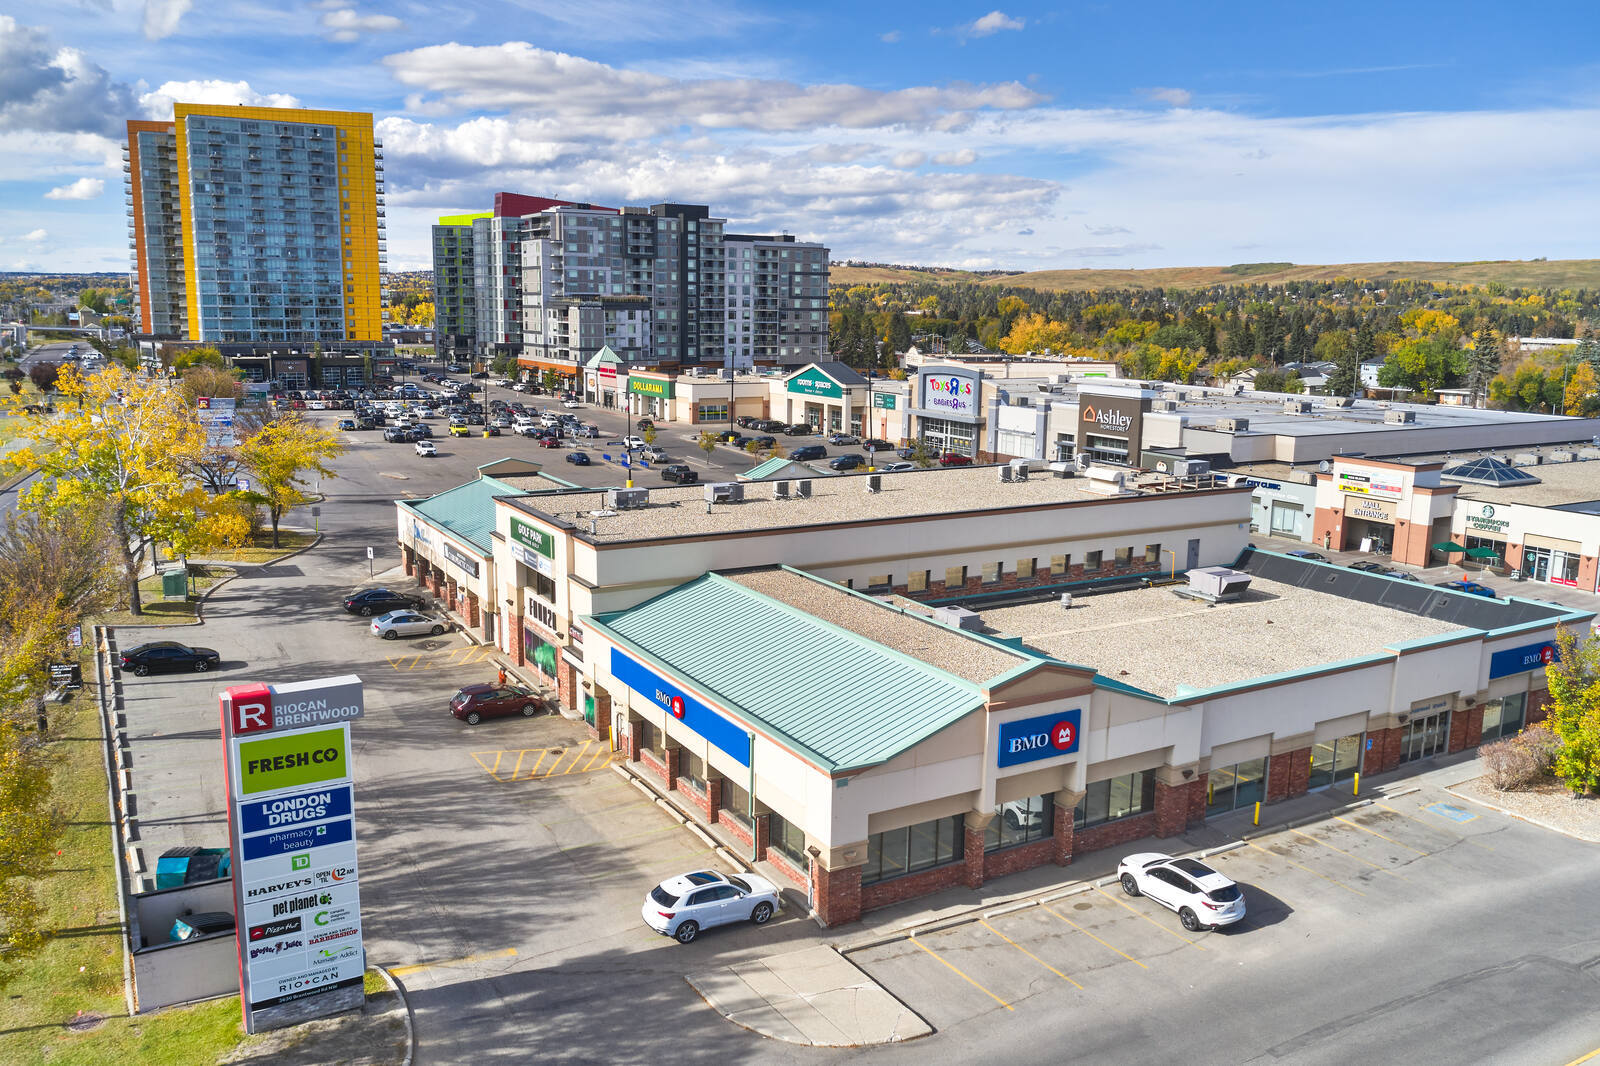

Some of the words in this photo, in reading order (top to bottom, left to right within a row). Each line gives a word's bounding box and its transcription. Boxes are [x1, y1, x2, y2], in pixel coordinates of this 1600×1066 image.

[633, 381, 664, 394] DOLLARAMA
[797, 378, 812, 387] rooms
[814, 380, 832, 390] spaces
[1095, 409, 1133, 431] Ashley
[1100, 423, 1126, 432] HOMESTORE
[1246, 479, 1260, 488] CITY
[1260, 481, 1281, 491] CLINIC
[1353, 507, 1389, 520] ENTRANCE
[1362, 500, 1382, 511] MALL
[1466, 515, 1510, 528] STARBUCKS
[1473, 522, 1502, 533] COFFEE
[517, 523, 530, 538] GOLF
[529, 528, 543, 545] PARK
[1523, 652, 1542, 666] BMO
[655, 688, 672, 708] BMO
[274, 699, 327, 716] RIOCAN
[238, 703, 268, 729] R
[275, 705, 359, 727] BRENTWOOD
[1008, 733, 1049, 753] BMO
[248, 751, 309, 775] FRESH
[312, 747, 339, 764] CO
[262, 793, 331, 816] LONDON
[268, 806, 327, 826] DRUGS
[269, 828, 314, 844] pharmacy
[283, 838, 314, 851] beauty
[293, 855, 309, 870] TD
[315, 870, 331, 879] OPEN
[336, 868, 346, 877] 12
[247, 877, 312, 898] HARVEY'S
[272, 900, 289, 918] pet
[289, 893, 319, 914] planet
[265, 926, 285, 936] Pizza
[285, 922, 301, 931] Hut
[309, 928, 359, 945] BARBERSHOP
[250, 946, 276, 959] Booster
[283, 940, 303, 951] Juice
[340, 950, 358, 959] Addict
[278, 977, 297, 985] OWNED
[308, 968, 331, 977] MANAGED
[279, 981, 303, 993] RIO
[312, 971, 339, 984] CAN
